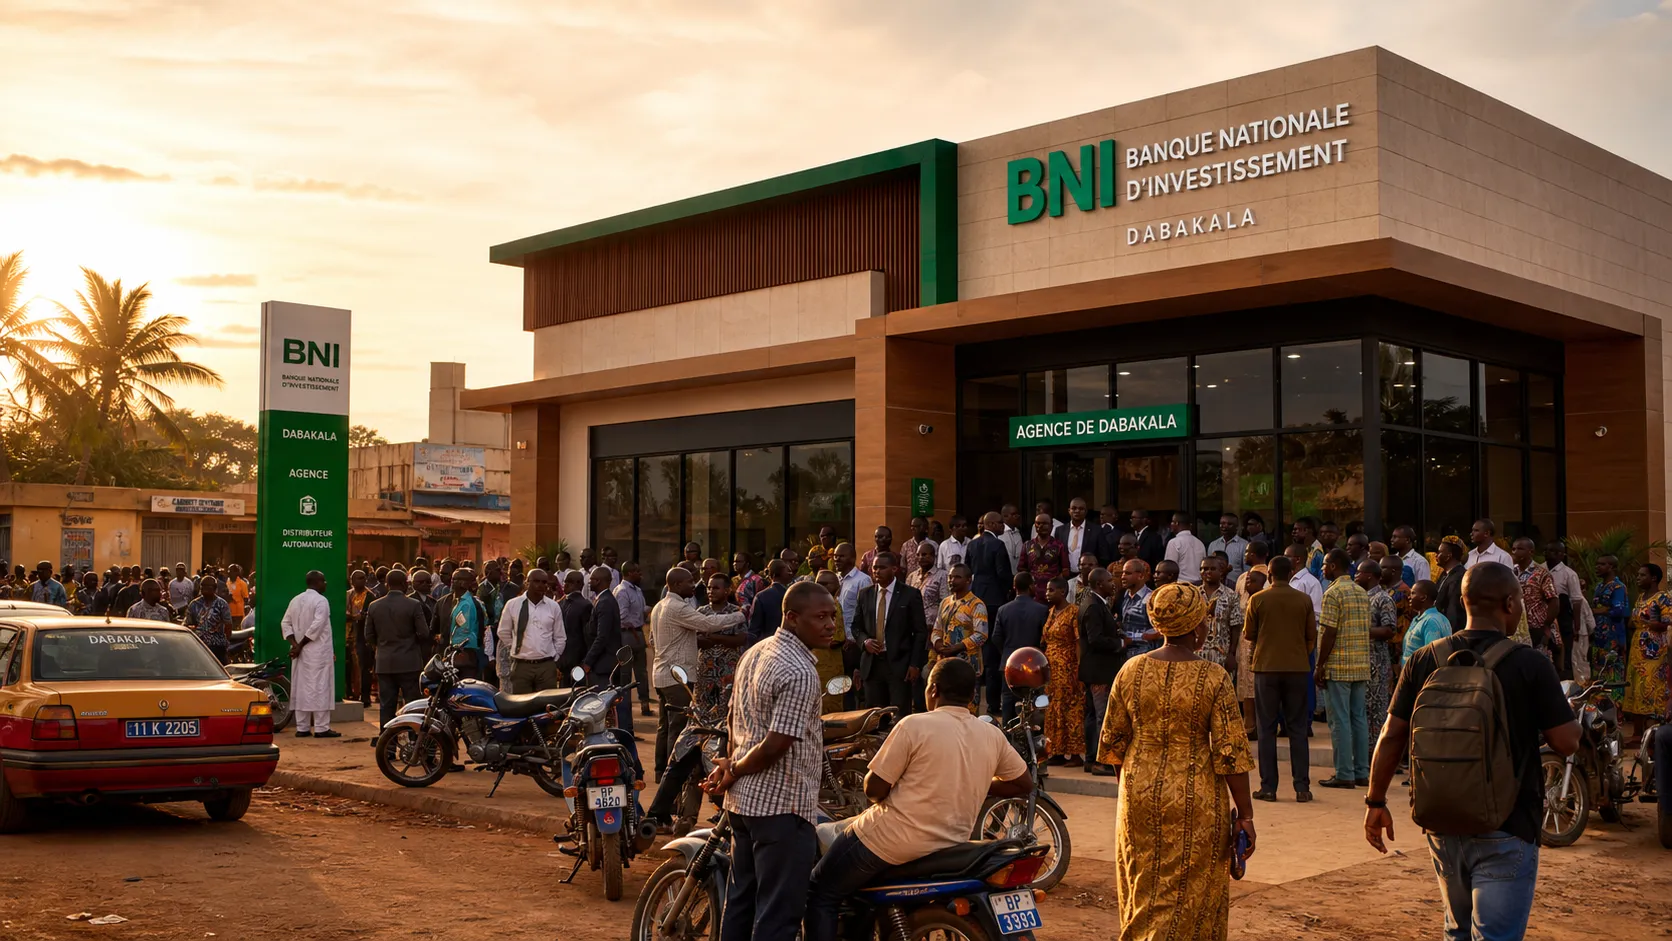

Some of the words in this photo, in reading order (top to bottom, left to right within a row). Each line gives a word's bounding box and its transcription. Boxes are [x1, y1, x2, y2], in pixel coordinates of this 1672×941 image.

[1126, 132, 1214, 169] BANQUE
[1219, 103, 1350, 149] NATIONALE
[1126, 139, 1348, 201] D'INVESTISSEMENT
[1008, 139, 1116, 225] BNI
[1127, 208, 1256, 246] DABAKALA
[283, 338, 340, 368] BNI
[282, 382, 339, 391] D'INVESTISSEMENT
[307, 376, 340, 384] NATIONALE
[1016, 421, 1072, 439] AGENCE
[1076, 420, 1095, 435] DE
[1099, 414, 1177, 433] DABAKALA
[282, 428, 337, 441] DABAKALA
[289, 468, 328, 479] AGENCE
[282, 529, 333, 537] DISTRIBUTEUR
[89, 635, 159, 644] DABAKALA
[134, 722, 146, 735] 11
[152, 722, 160, 735] K
[165, 721, 197, 735] 2205
